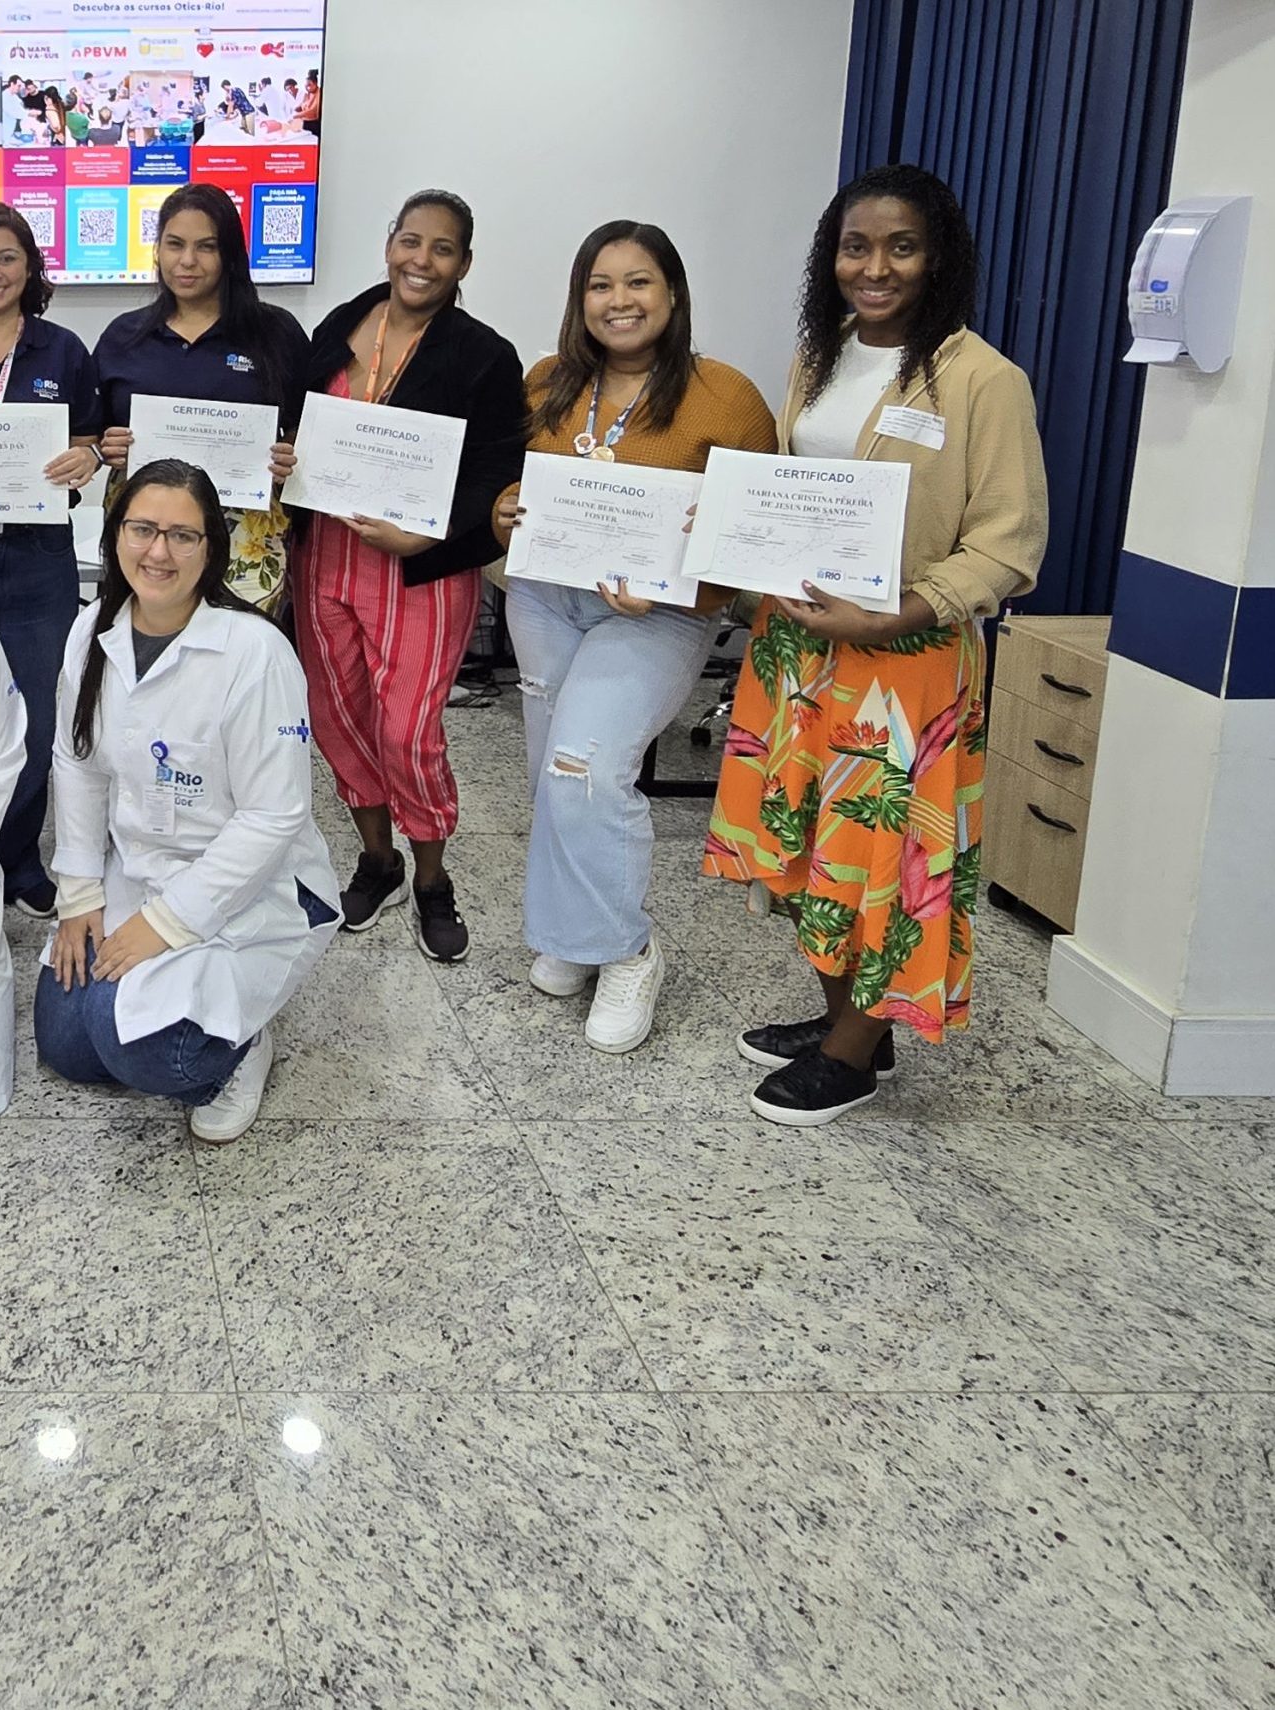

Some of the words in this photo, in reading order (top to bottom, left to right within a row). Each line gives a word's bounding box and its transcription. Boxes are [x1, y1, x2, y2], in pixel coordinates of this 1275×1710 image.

[73, 2, 120, 12] Descubra
[124, 4, 135, 12] os
[138, 4, 171, 12] cursos
[83, 46, 127, 57] PBVM
[173, 405, 238, 419] CERTIFICADO
[356, 423, 420, 443] CERTIFICADO
[774, 468, 855, 484] CERTIFICADO
[569, 478, 646, 498] CERTIFICADO
[553, 496, 596, 510] LORRAINE
[747, 488, 790, 500] MARIANA
[791, 492, 833, 504] CRISTINA
[835, 496, 874, 508] PEREIRA
[761, 500, 773, 509] DE
[775, 502, 801, 511] JESUS
[803, 504, 821, 513] DOS
[584, 511, 618, 523] FOSTER
[825, 571, 841, 581] RIO
[278, 726, 296, 736] SUS
